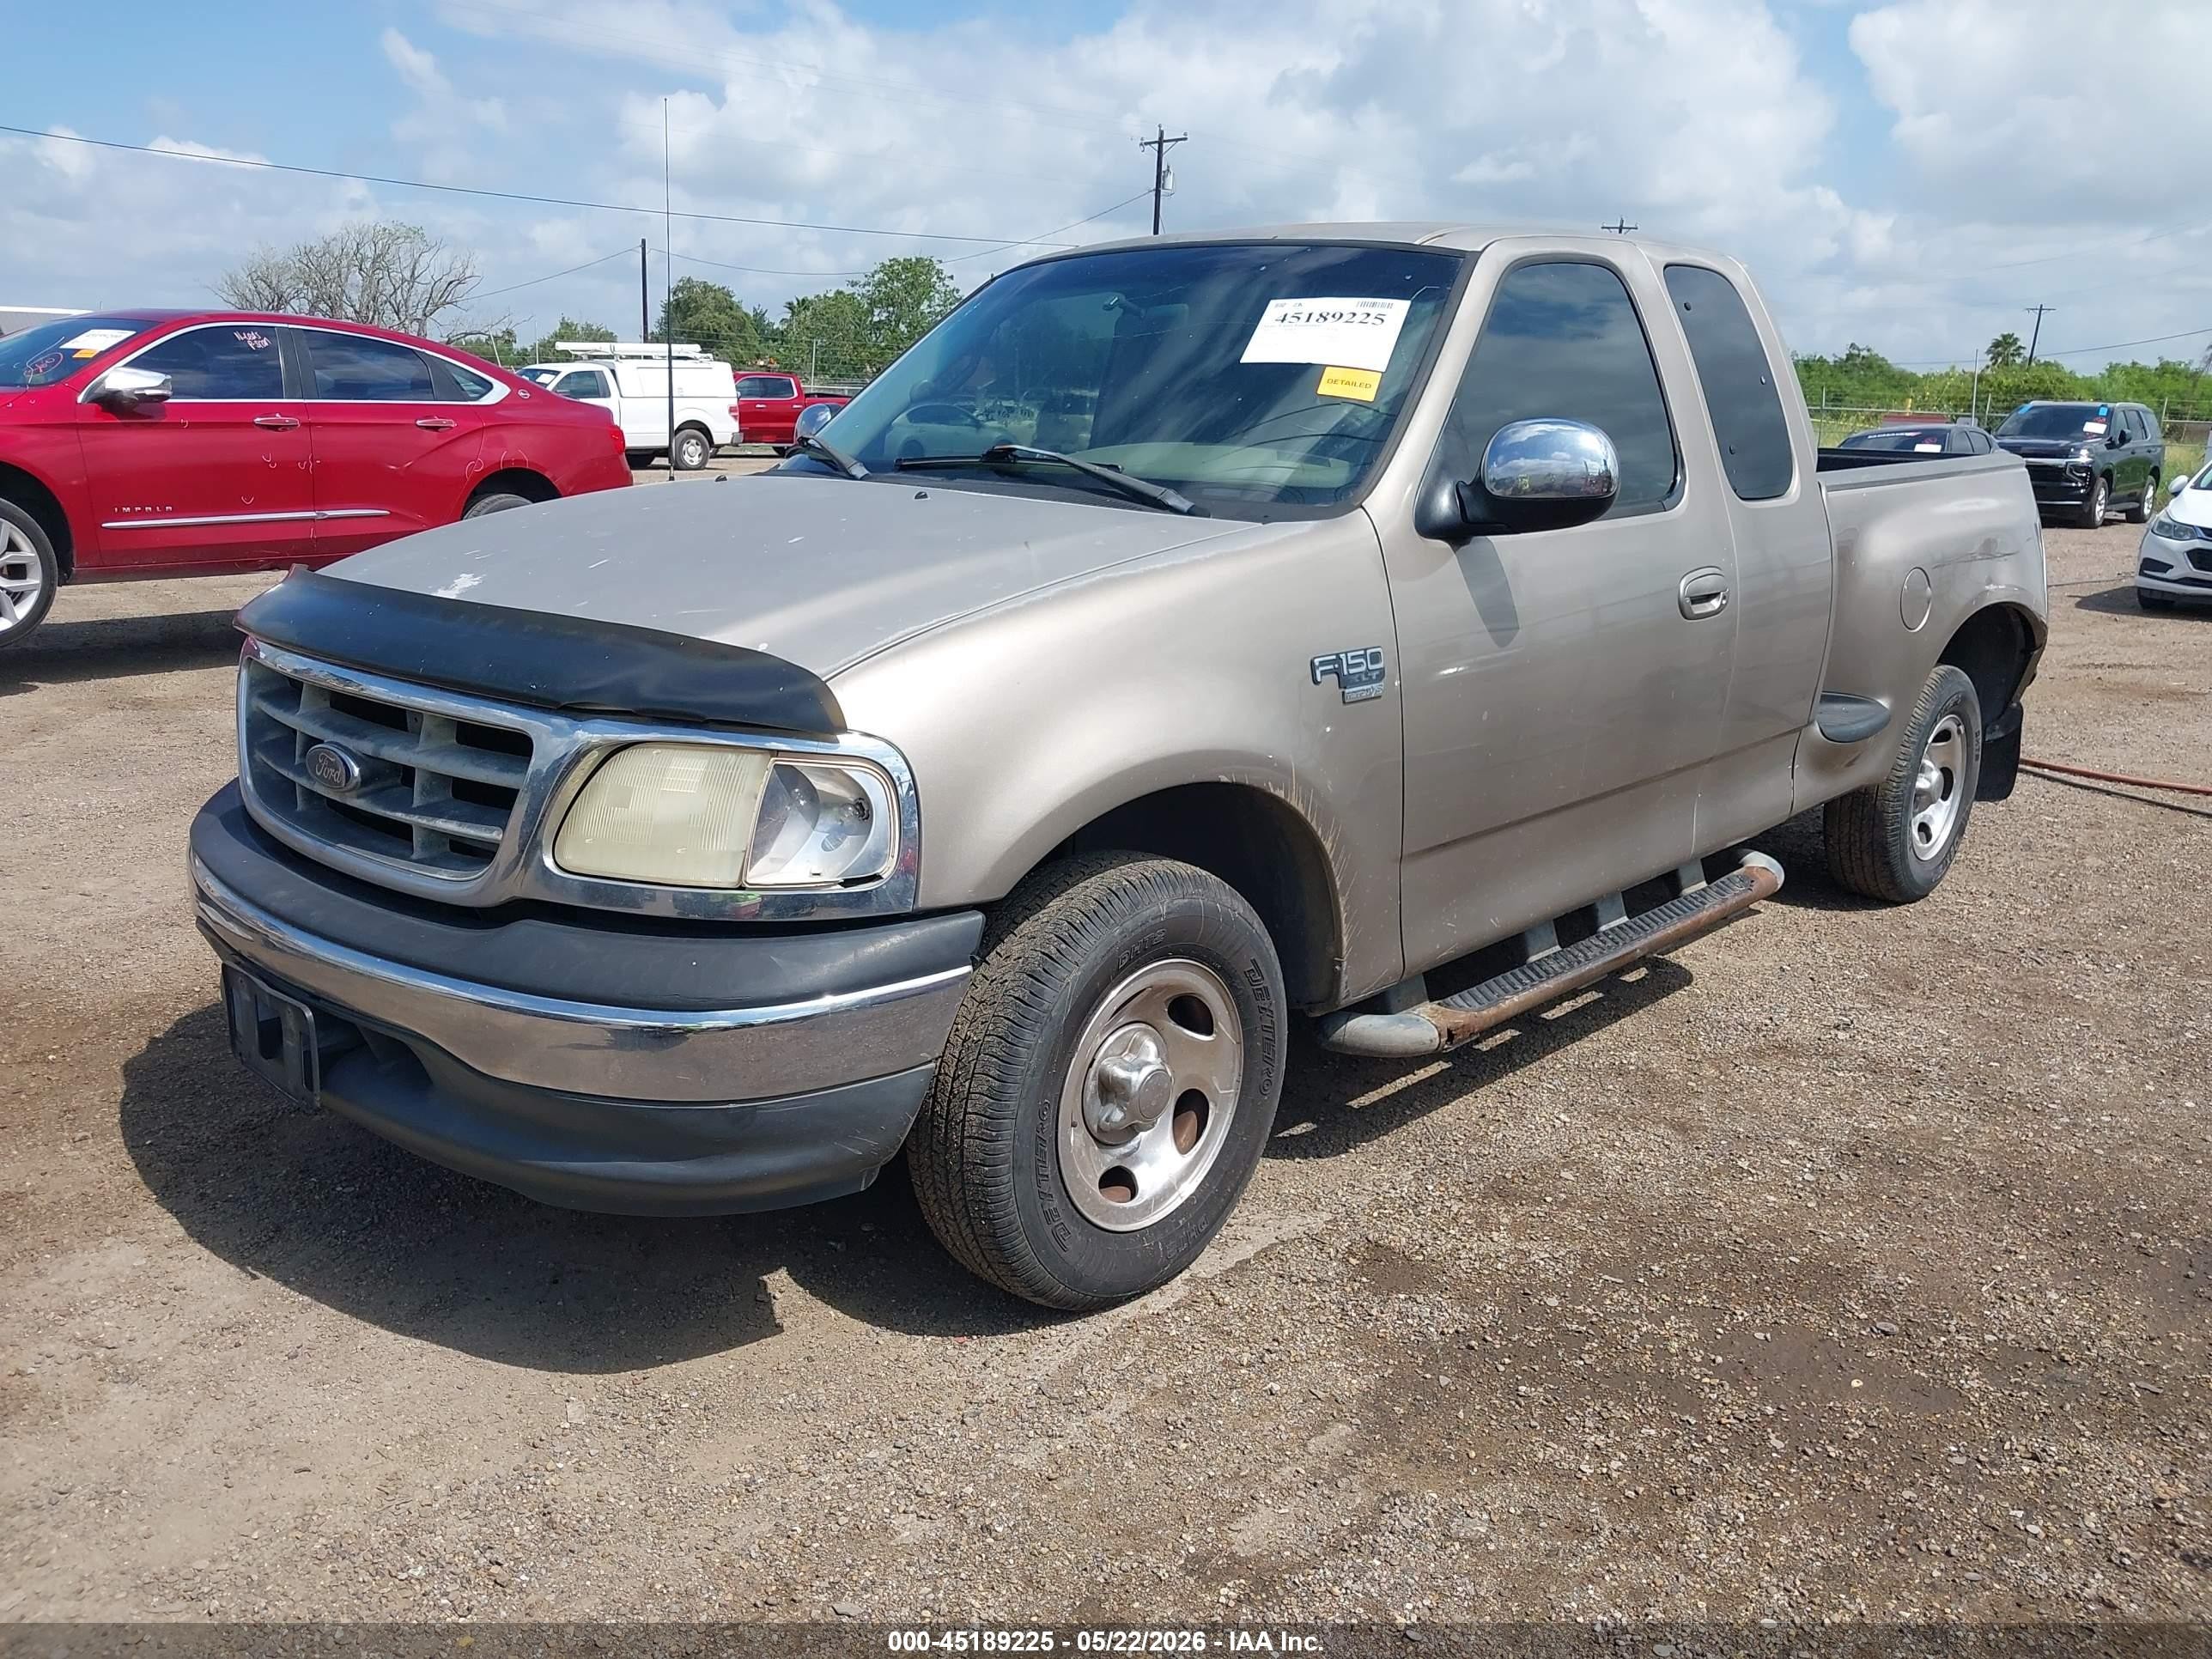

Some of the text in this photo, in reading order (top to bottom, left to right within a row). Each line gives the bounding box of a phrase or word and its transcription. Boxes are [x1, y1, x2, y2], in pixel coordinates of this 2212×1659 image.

[1274, 311, 1388, 325] 45189225
[1327, 378, 1372, 389] DETAILED
[315, 752, 342, 783] Ford
[1117, 927, 1168, 969] DHT2
[1243, 957, 1276, 1097] DEXTERO
[1035, 1100, 1072, 1253] DEXTERO
